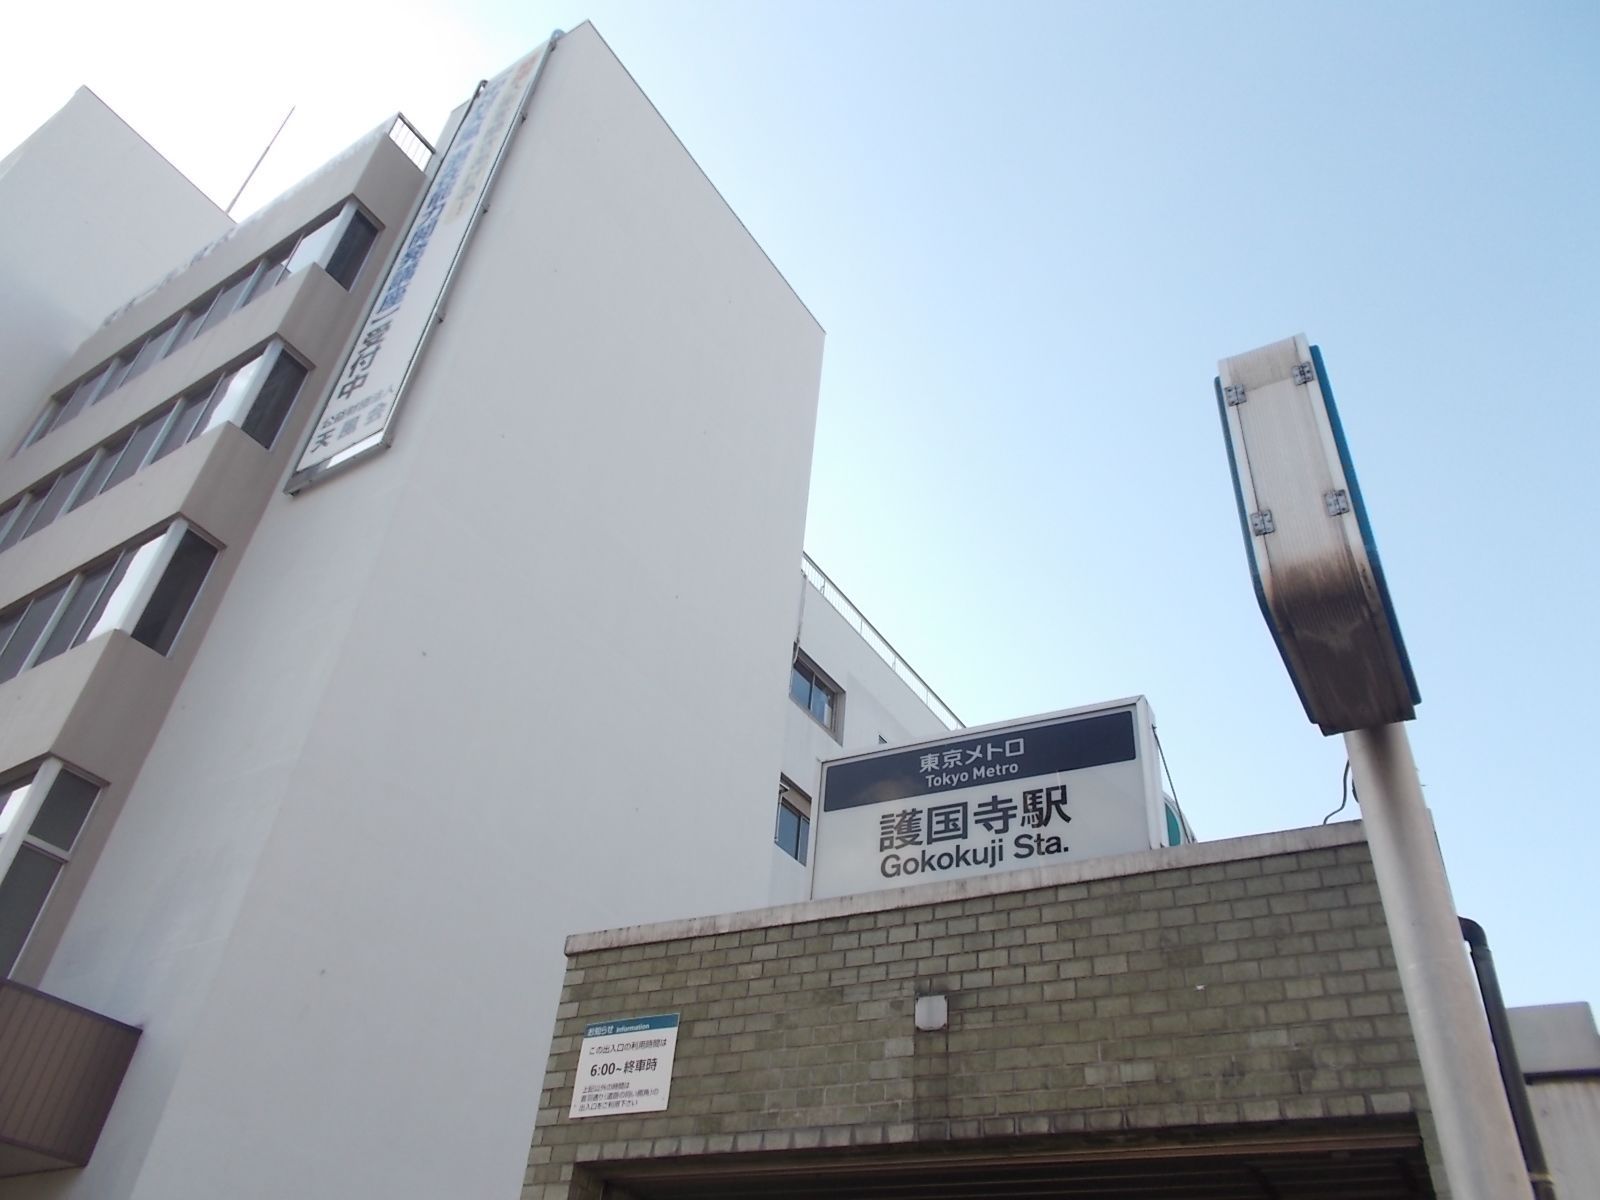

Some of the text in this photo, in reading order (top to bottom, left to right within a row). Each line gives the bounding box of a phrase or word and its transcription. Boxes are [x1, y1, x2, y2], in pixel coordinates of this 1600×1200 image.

[919, 738, 1025, 773] 東京メトロ
[925, 762, 1019, 788] Tokyo Metro
[879, 784, 1072, 852] 護国寺駅
[880, 833, 1069, 878] Gokokuji Sta.
[587, 1025, 614, 1037] お知らせ
[589, 1038, 667, 1055] この出入口の利用時間は
